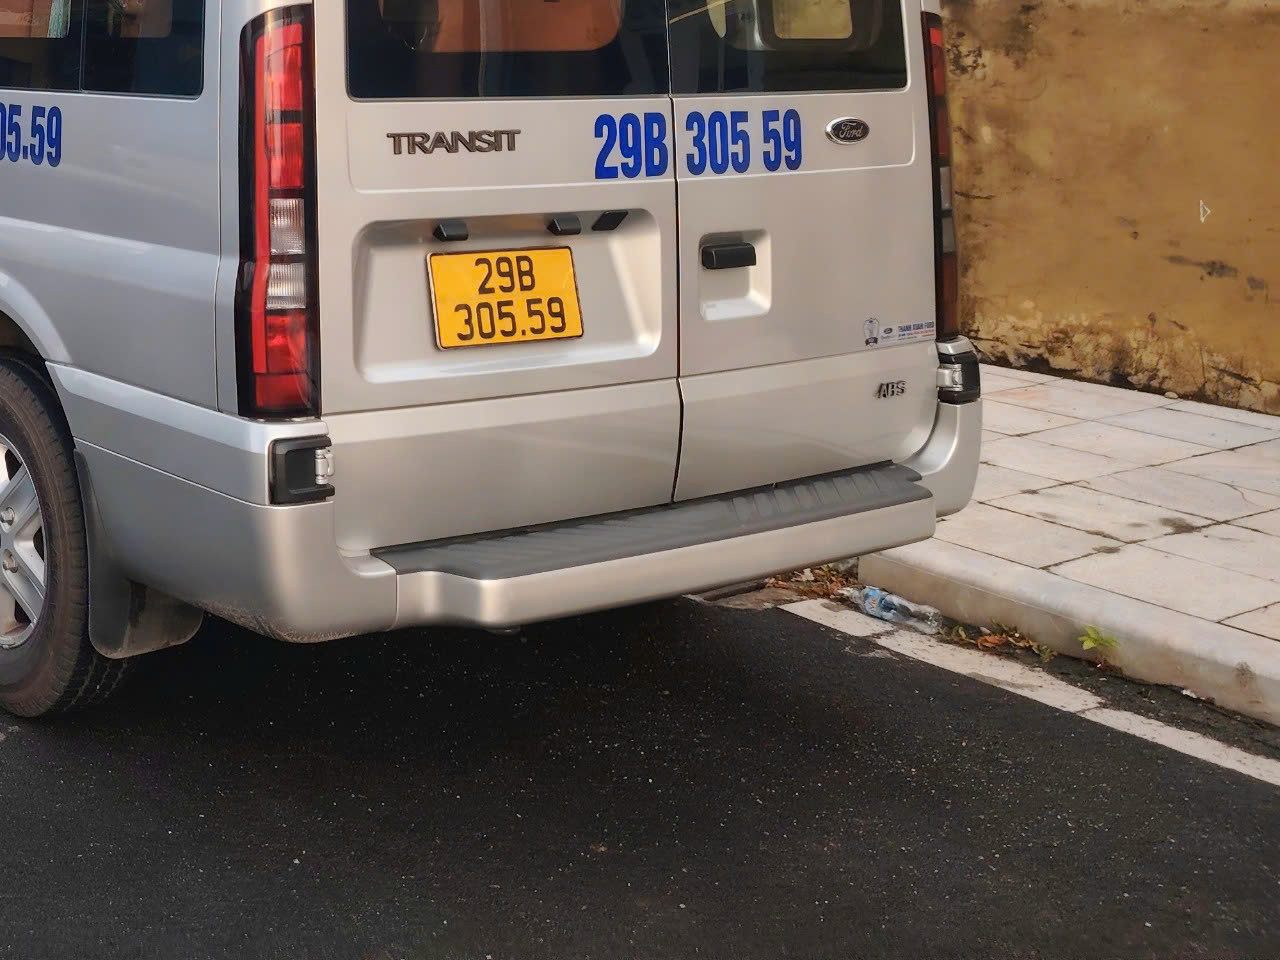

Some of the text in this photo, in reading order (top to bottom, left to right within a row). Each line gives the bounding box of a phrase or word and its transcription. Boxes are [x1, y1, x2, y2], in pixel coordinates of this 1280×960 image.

[386, 128, 521, 155] TRANSIT
[593, 108, 802, 180] 29B 305 59
[838, 121, 865, 139] Ford
[474, 255, 536, 295] 29B
[454, 296, 567, 341] 305.59
[876, 380, 906, 399] ABS
